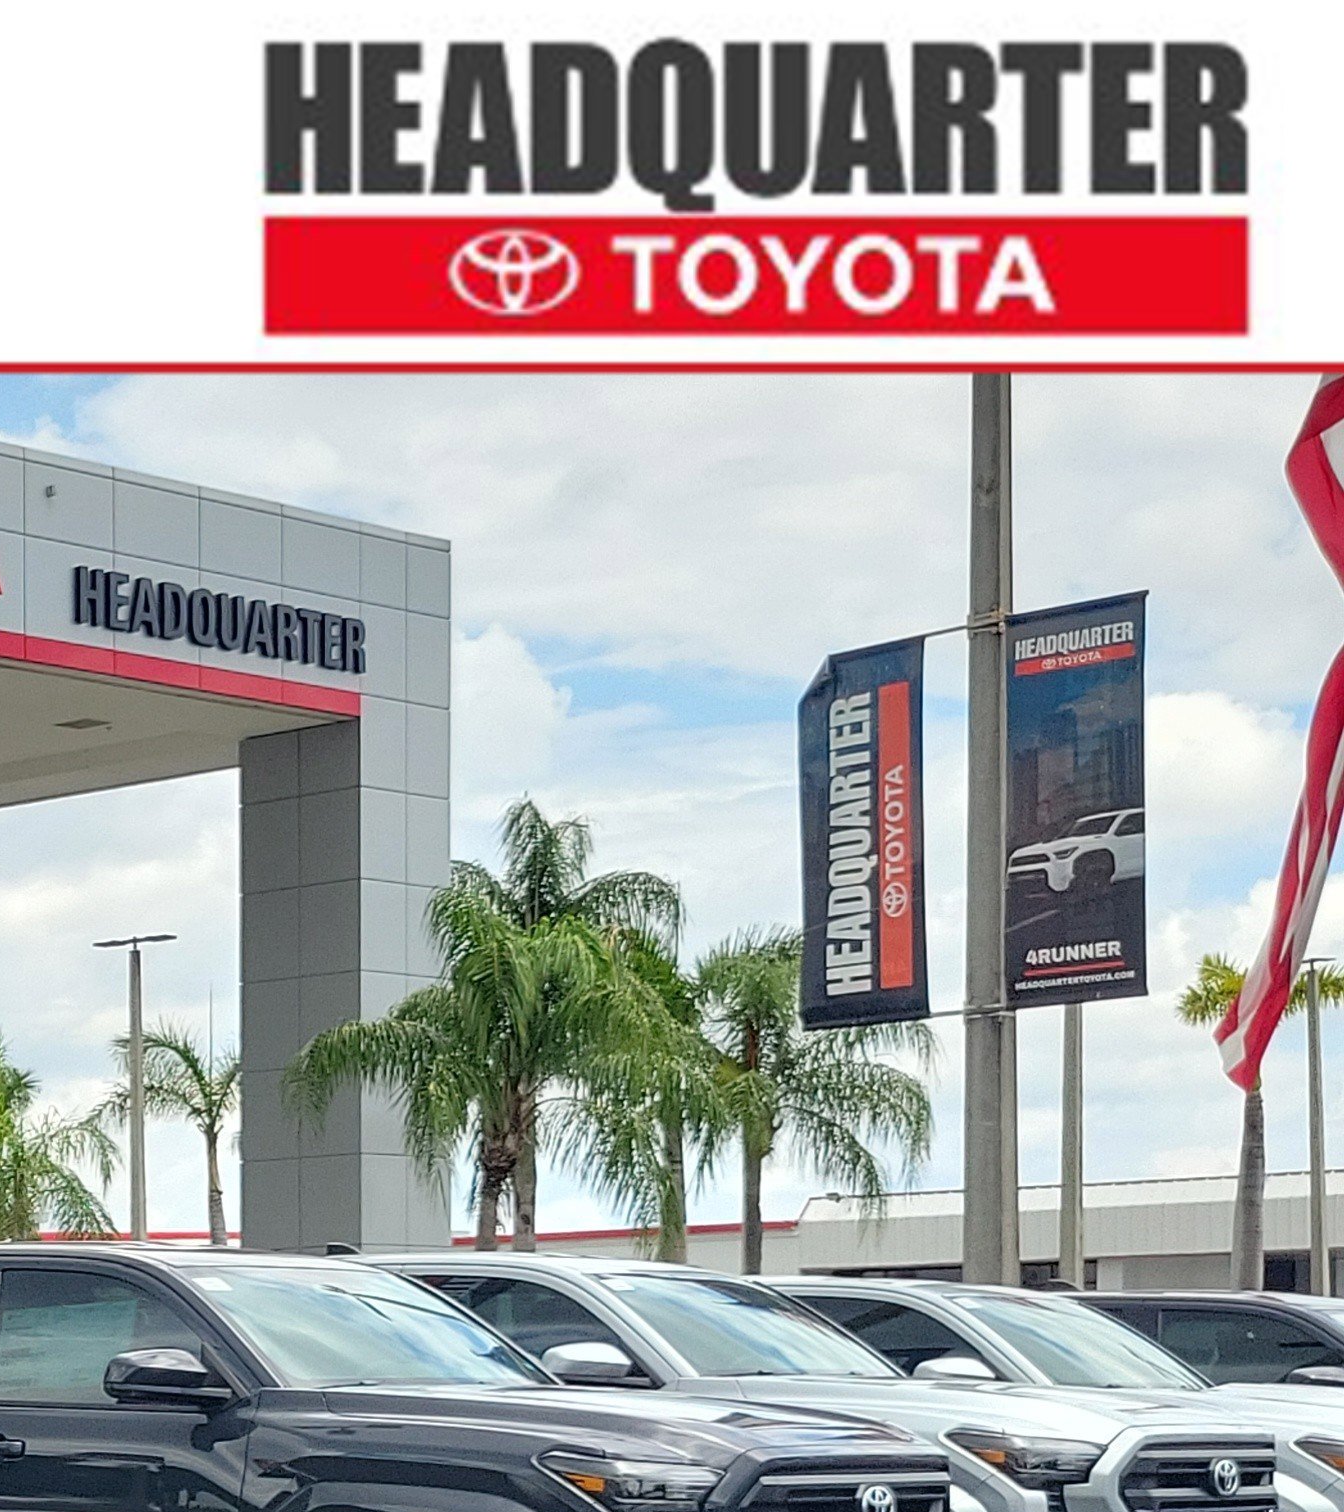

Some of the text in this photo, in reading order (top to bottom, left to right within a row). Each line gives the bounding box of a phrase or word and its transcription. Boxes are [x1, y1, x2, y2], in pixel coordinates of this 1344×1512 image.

[73, 566, 367, 674] HEADQUARTER
[1014, 621, 1134, 660] HEADQUARTER
[1058, 651, 1102, 667] TOYOTA
[883, 764, 905, 880] TOYOTA
[826, 692, 878, 996] HEADQUARTER
[1025, 940, 1122, 966] 4RUNNER
[1014, 970, 1136, 991] HEADQUARTERTOYOTA.COM
